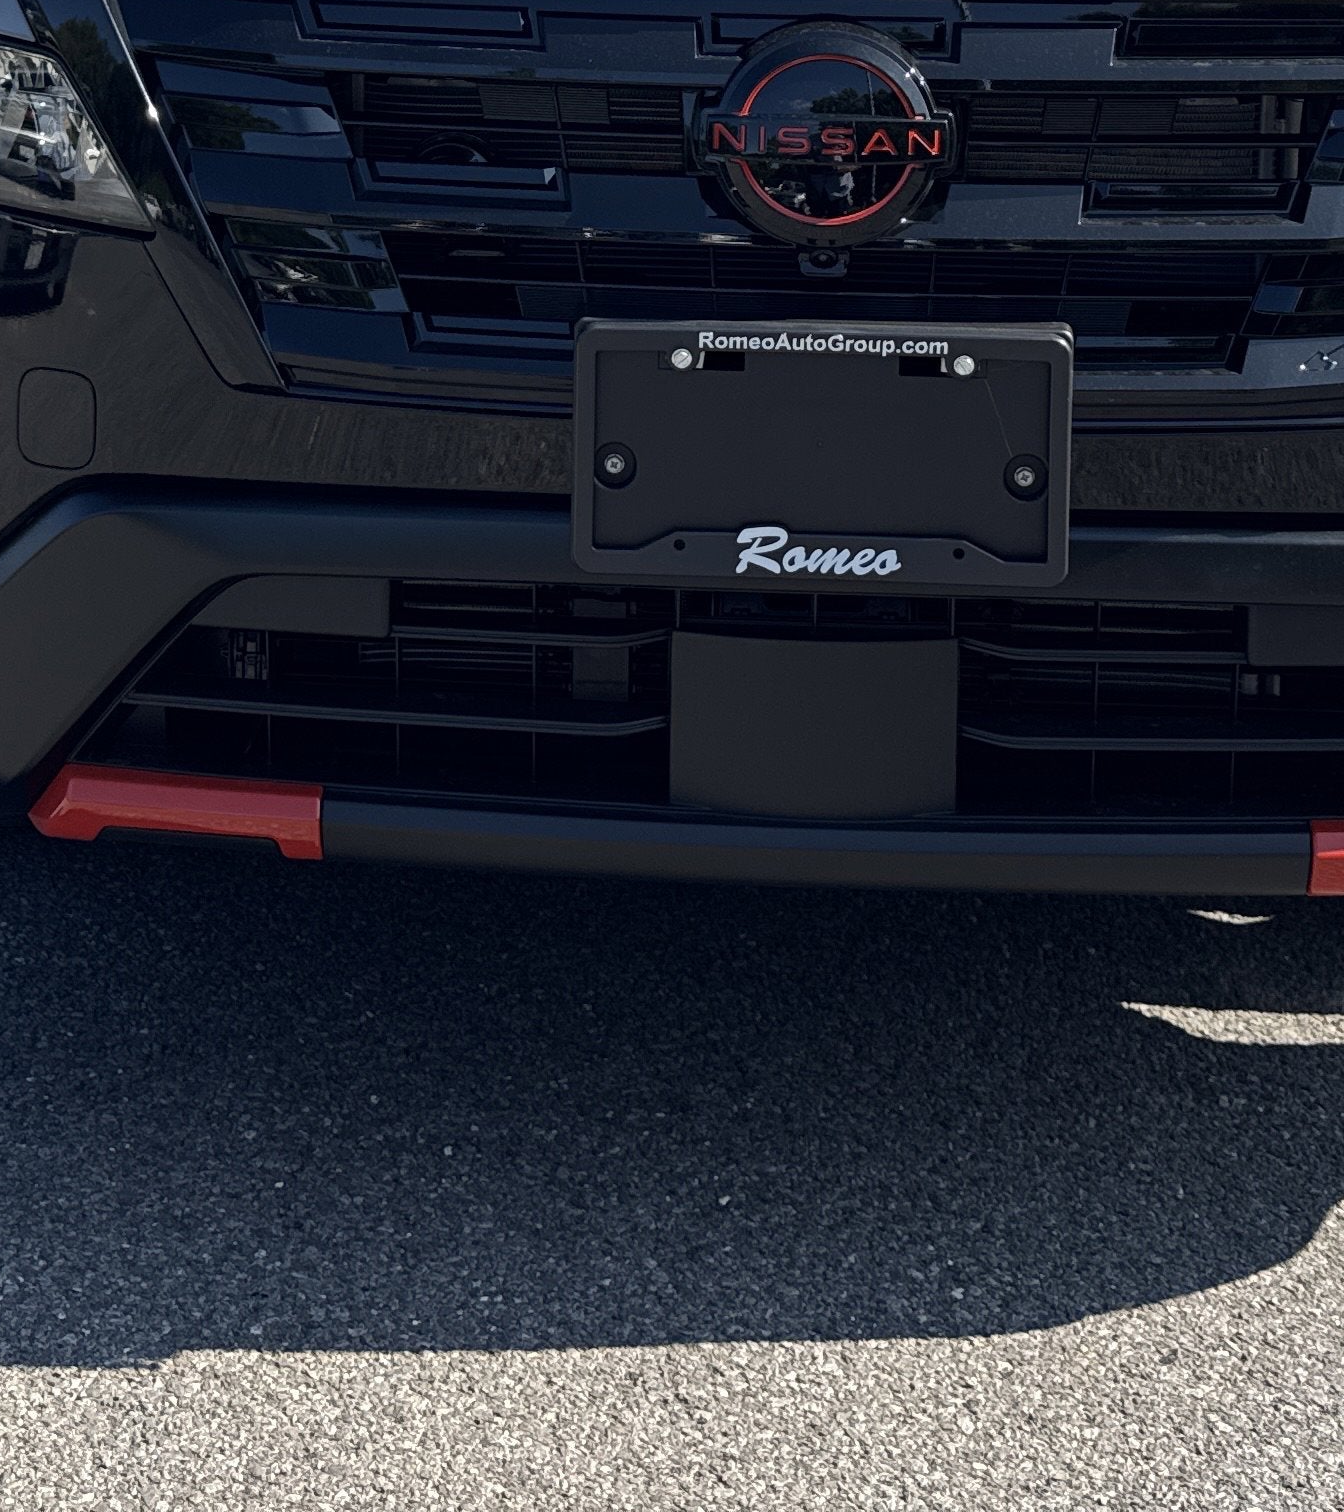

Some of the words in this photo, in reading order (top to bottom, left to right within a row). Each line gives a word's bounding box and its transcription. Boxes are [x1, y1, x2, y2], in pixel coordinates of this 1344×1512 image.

[711, 122, 943, 156] NISSAN
[698, 331, 949, 357] RomeoAutoGroup.com
[736, 526, 902, 576] Romeo
